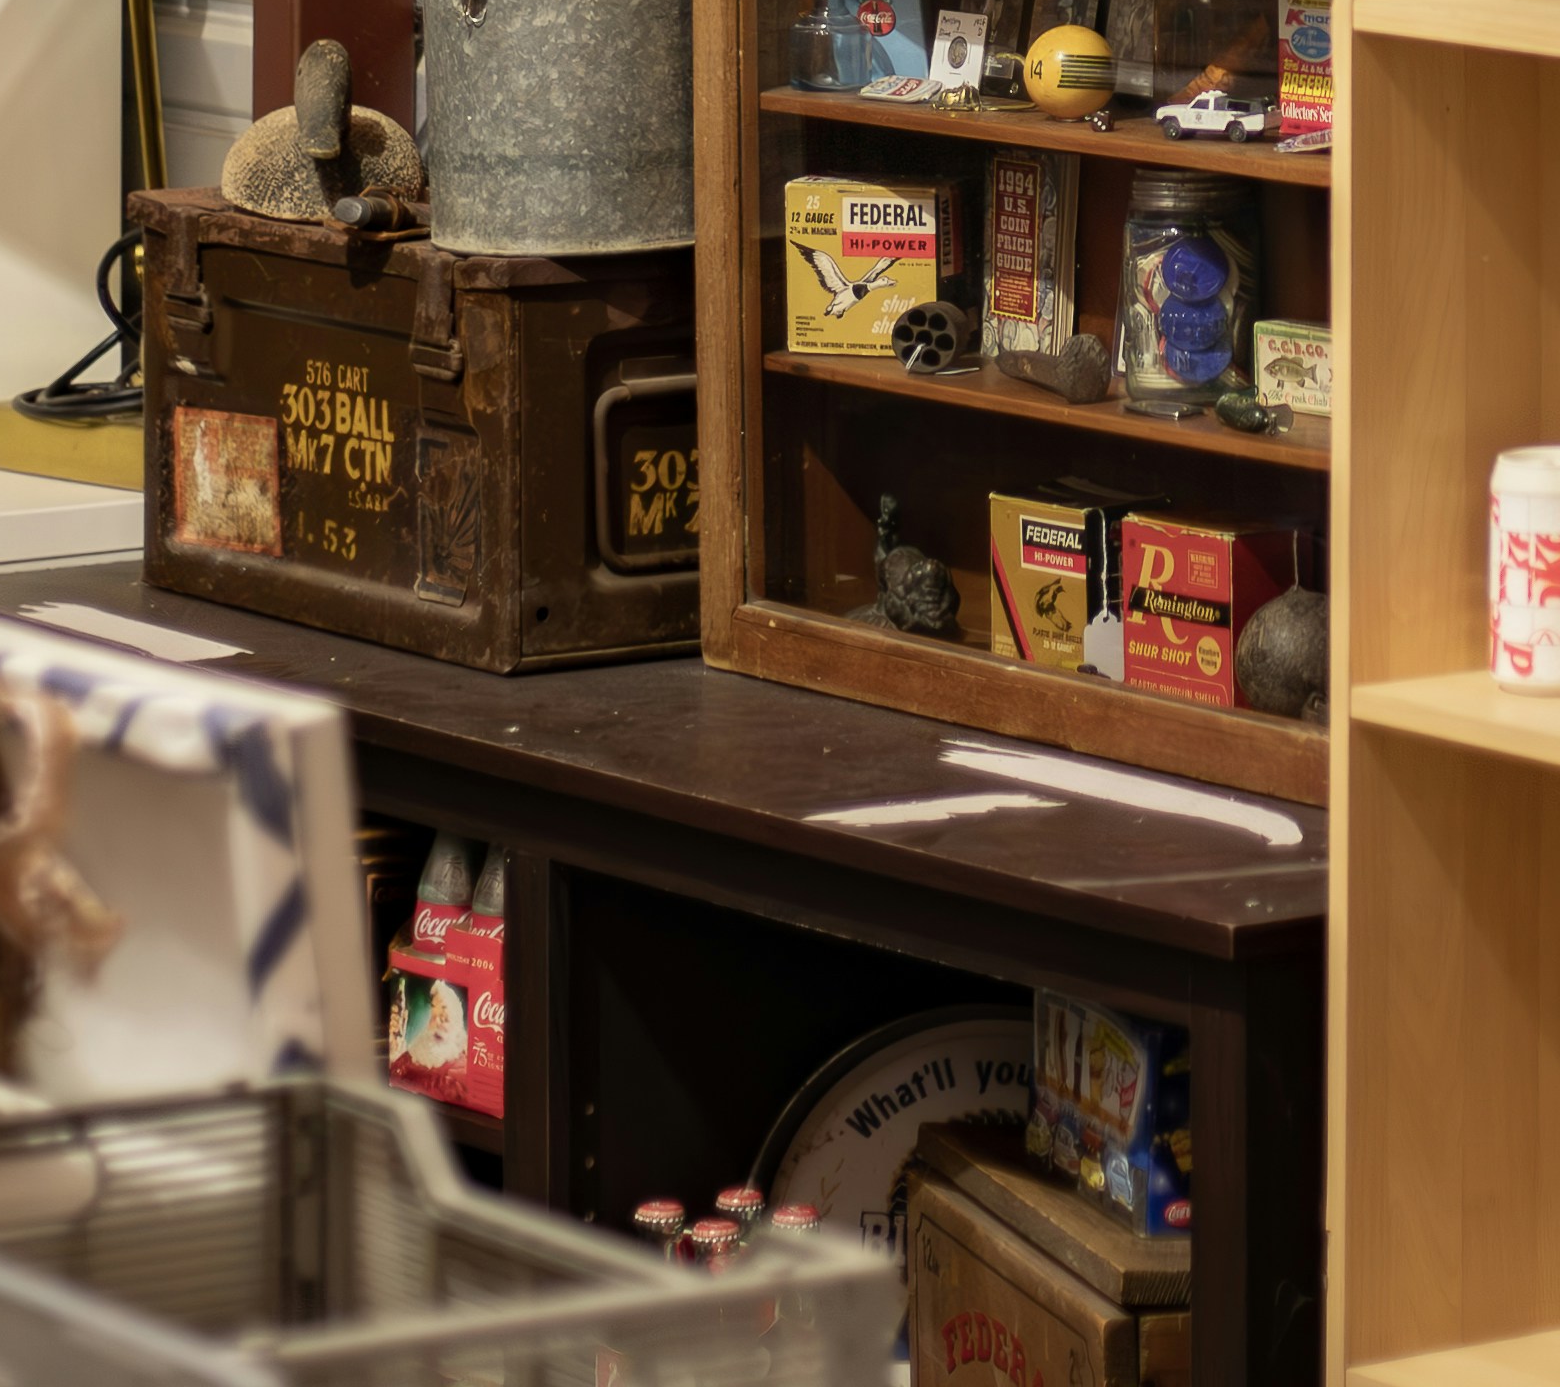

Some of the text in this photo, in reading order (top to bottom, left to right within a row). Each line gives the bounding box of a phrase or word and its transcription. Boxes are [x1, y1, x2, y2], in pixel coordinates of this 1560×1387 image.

[1285, 7, 1330, 27] Kmar
[1030, 58, 1043, 81] 14
[1281, 72, 1334, 98] BASEBA
[998, 168, 1035, 196] 1994
[806, 194, 820, 210] 25
[1003, 196, 1031, 215] U.S.
[791, 211, 835, 225] 12 GAUGE
[849, 202, 928, 227] FEDERAL
[1000, 215, 1030, 234] COIN
[849, 238, 928, 251] HI-POWER
[996, 233, 1033, 254] PRICE
[996, 252, 1033, 273] GUIDE
[306, 359, 370, 393] 576 CART
[334, 391, 395, 443] BALL
[343, 438, 392, 484] CTN
[1025, 525, 1083, 550] FEDERAL
[1034, 550, 1074, 568] HI-POWER
[1143, 589, 1217, 623] Remington
[1128, 639, 1192, 666] SHUR SHOT
[471, 955, 495, 972] 2006
[844, 1056, 957, 1139] What'll
[942, 1310, 1045, 1387] FEDER
